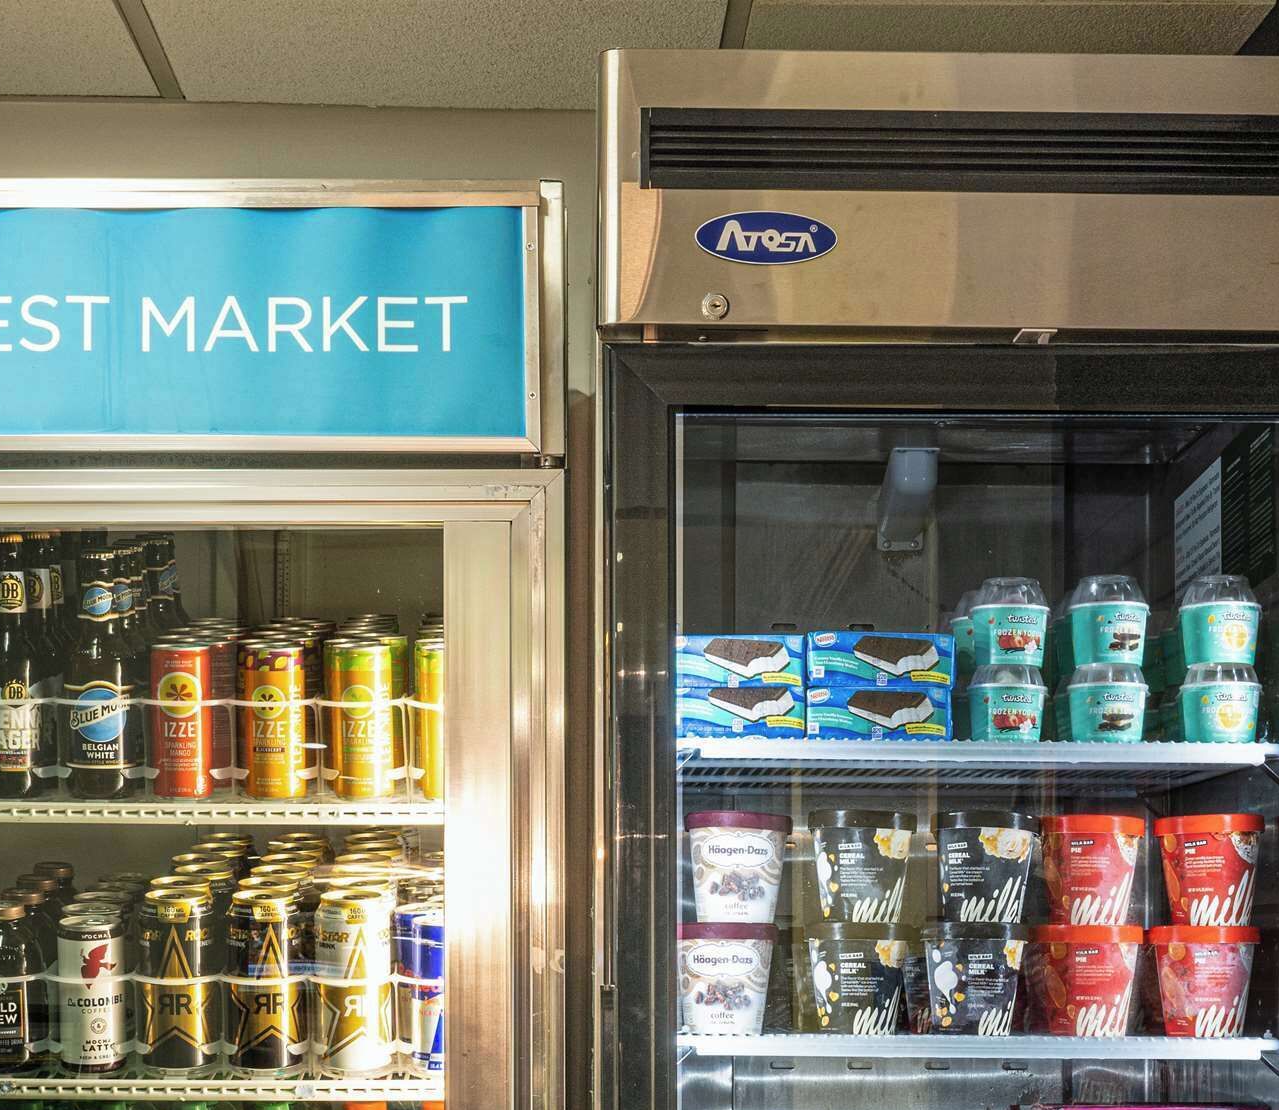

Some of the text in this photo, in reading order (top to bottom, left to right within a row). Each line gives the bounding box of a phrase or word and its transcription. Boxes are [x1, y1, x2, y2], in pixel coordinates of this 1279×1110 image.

[141, 294, 469, 352] MARKET
[164, 721, 199, 739] IZZE
[81, 742, 120, 752] BELGIAN
[86, 751, 116, 760] WHITE
[708, 844, 769, 857] Häagen-Dazs
[692, 954, 754, 966] Häagen-Dazs
